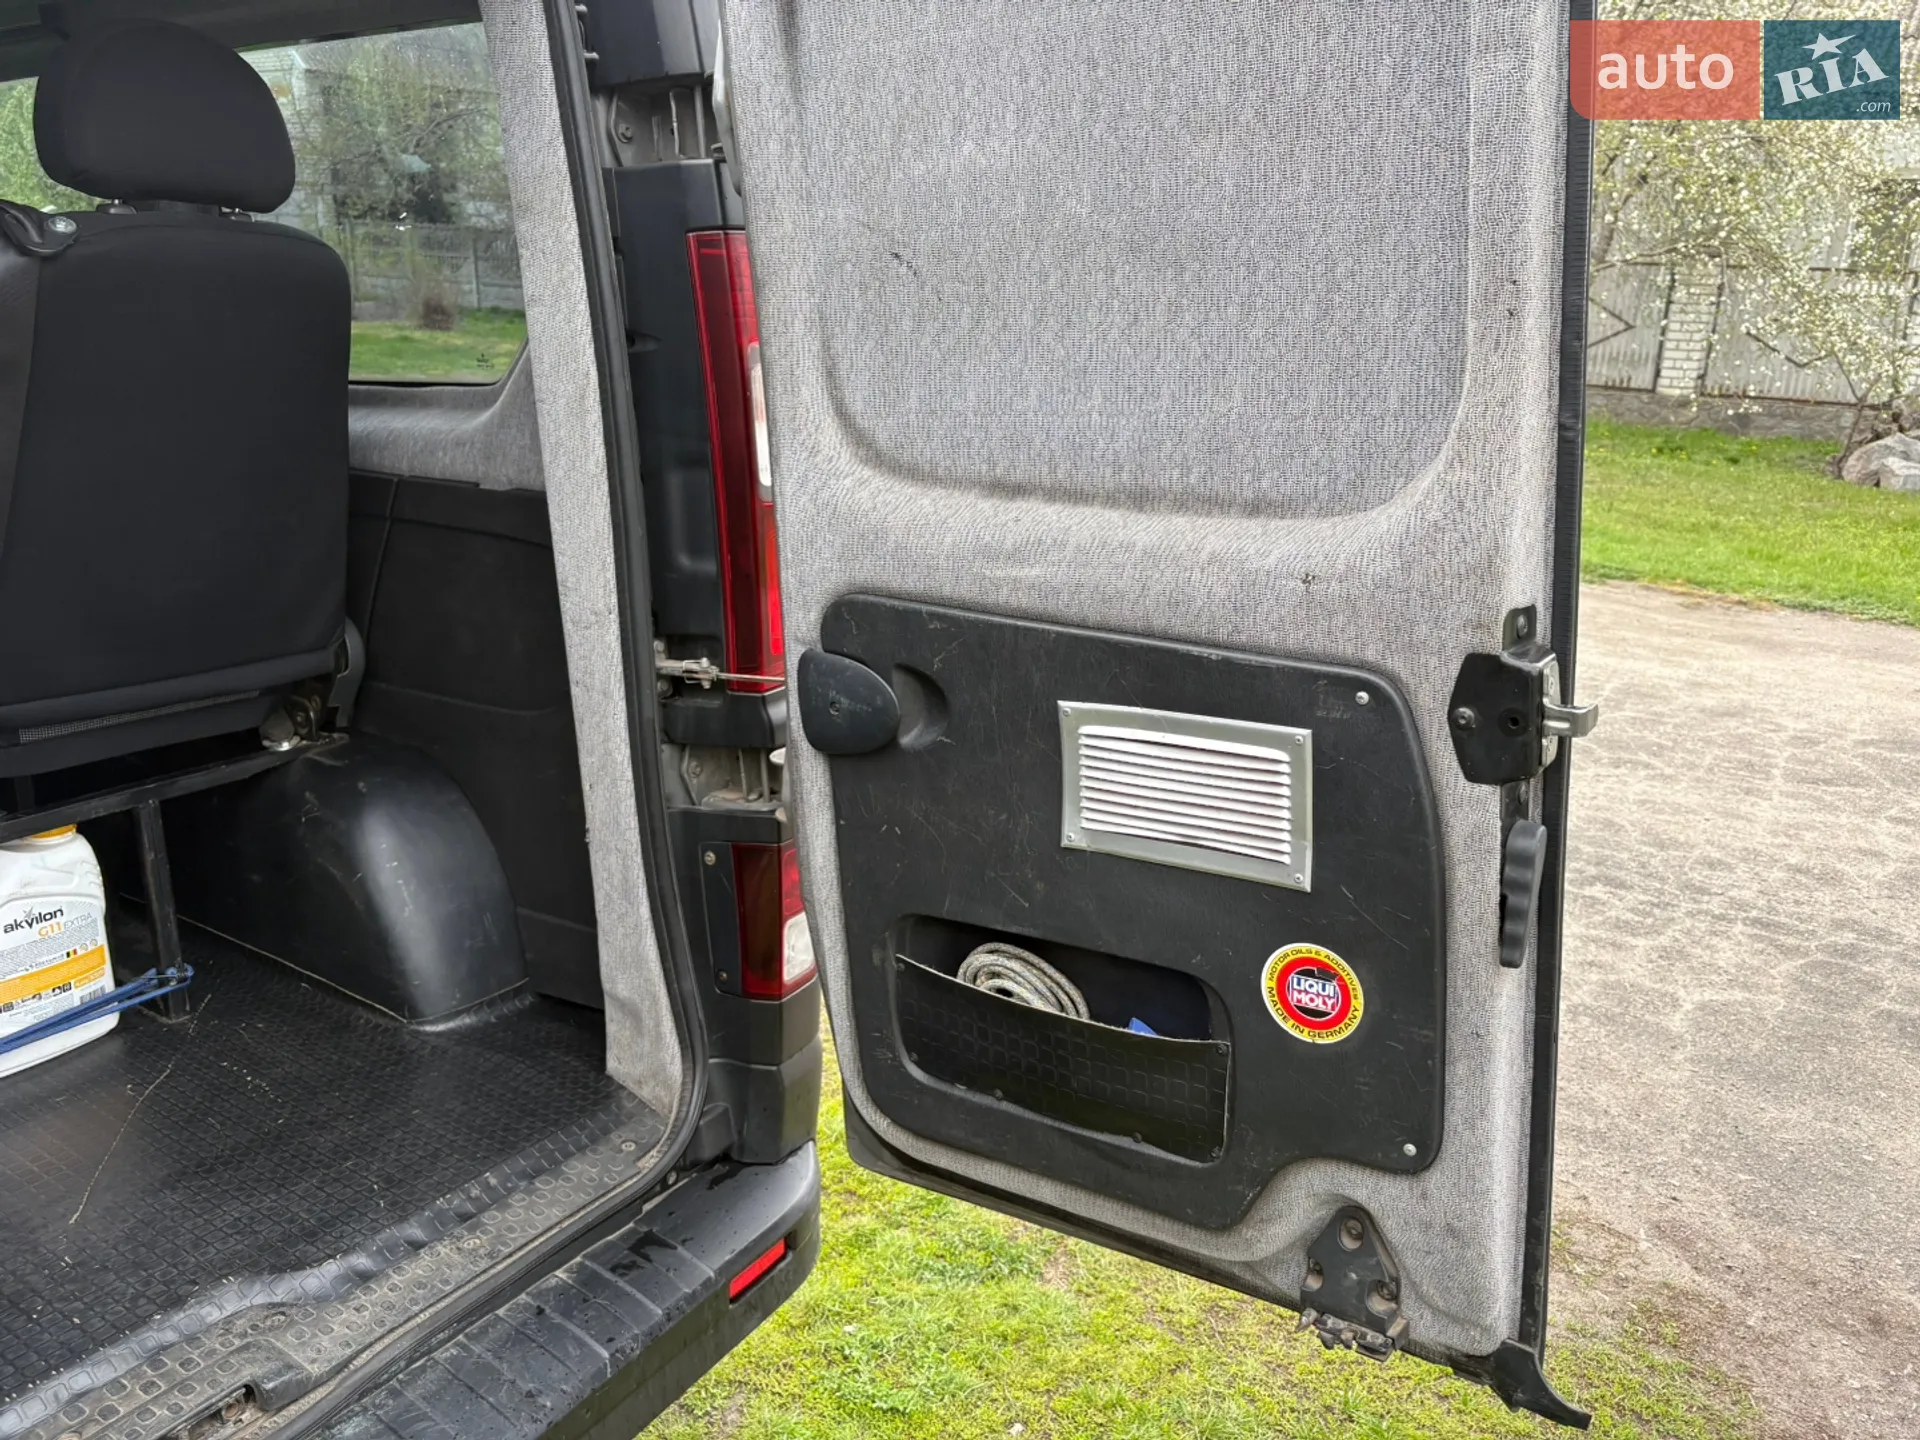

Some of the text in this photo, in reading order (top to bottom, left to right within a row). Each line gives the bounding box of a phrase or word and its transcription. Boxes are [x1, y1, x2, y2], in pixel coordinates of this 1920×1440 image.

[3, 908, 64, 934] akvilon
[38, 912, 93, 938] G11 EXTRA
[1268, 952, 1290, 982] MOTOR
[1290, 948, 1313, 956] OILS
[1293, 977, 1335, 997] LIQUI
[1267, 986, 1360, 1039] MADE IN GERMANY
[1293, 991, 1335, 1010] MOLY
